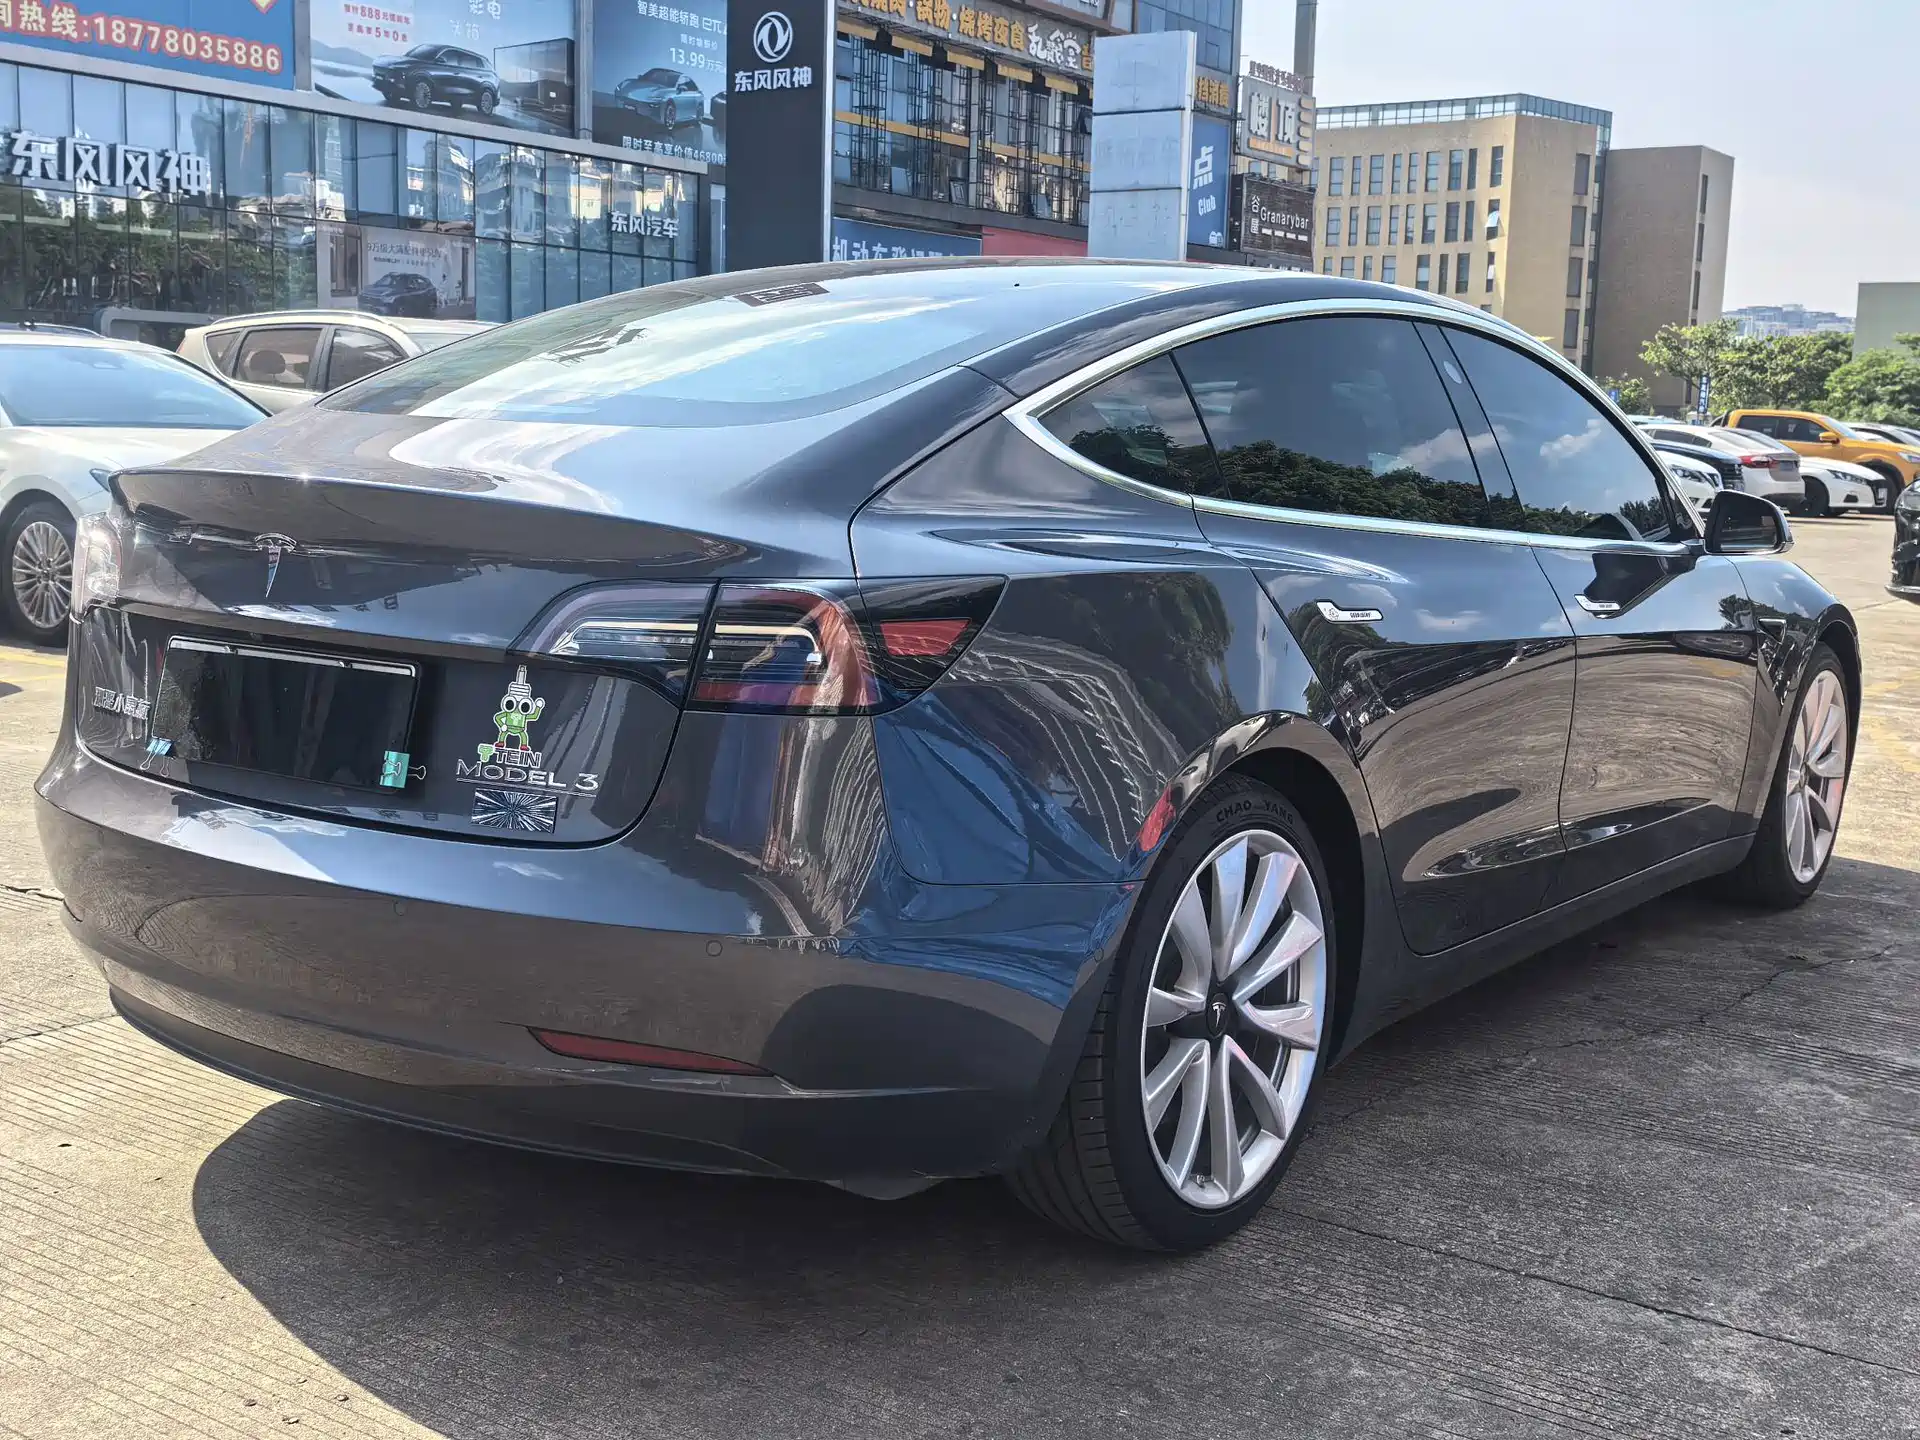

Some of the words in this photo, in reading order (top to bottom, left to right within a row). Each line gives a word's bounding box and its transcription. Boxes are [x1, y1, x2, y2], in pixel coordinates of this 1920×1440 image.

[734, 66, 812, 92] 东风风神
[622, 135, 727, 165] 限时至高享价值46800
[11, 131, 209, 196] 东风风神
[1198, 194, 1217, 216] Club
[1260, 206, 1309, 230] Granarybar
[611, 210, 679, 238] 东风汽车
[495, 749, 541, 769] TEIN
[456, 758, 567, 788] MODEL
[575, 772, 600, 791] 3
[1215, 800, 1252, 823] CHAO
[1263, 799, 1293, 825] YANG
